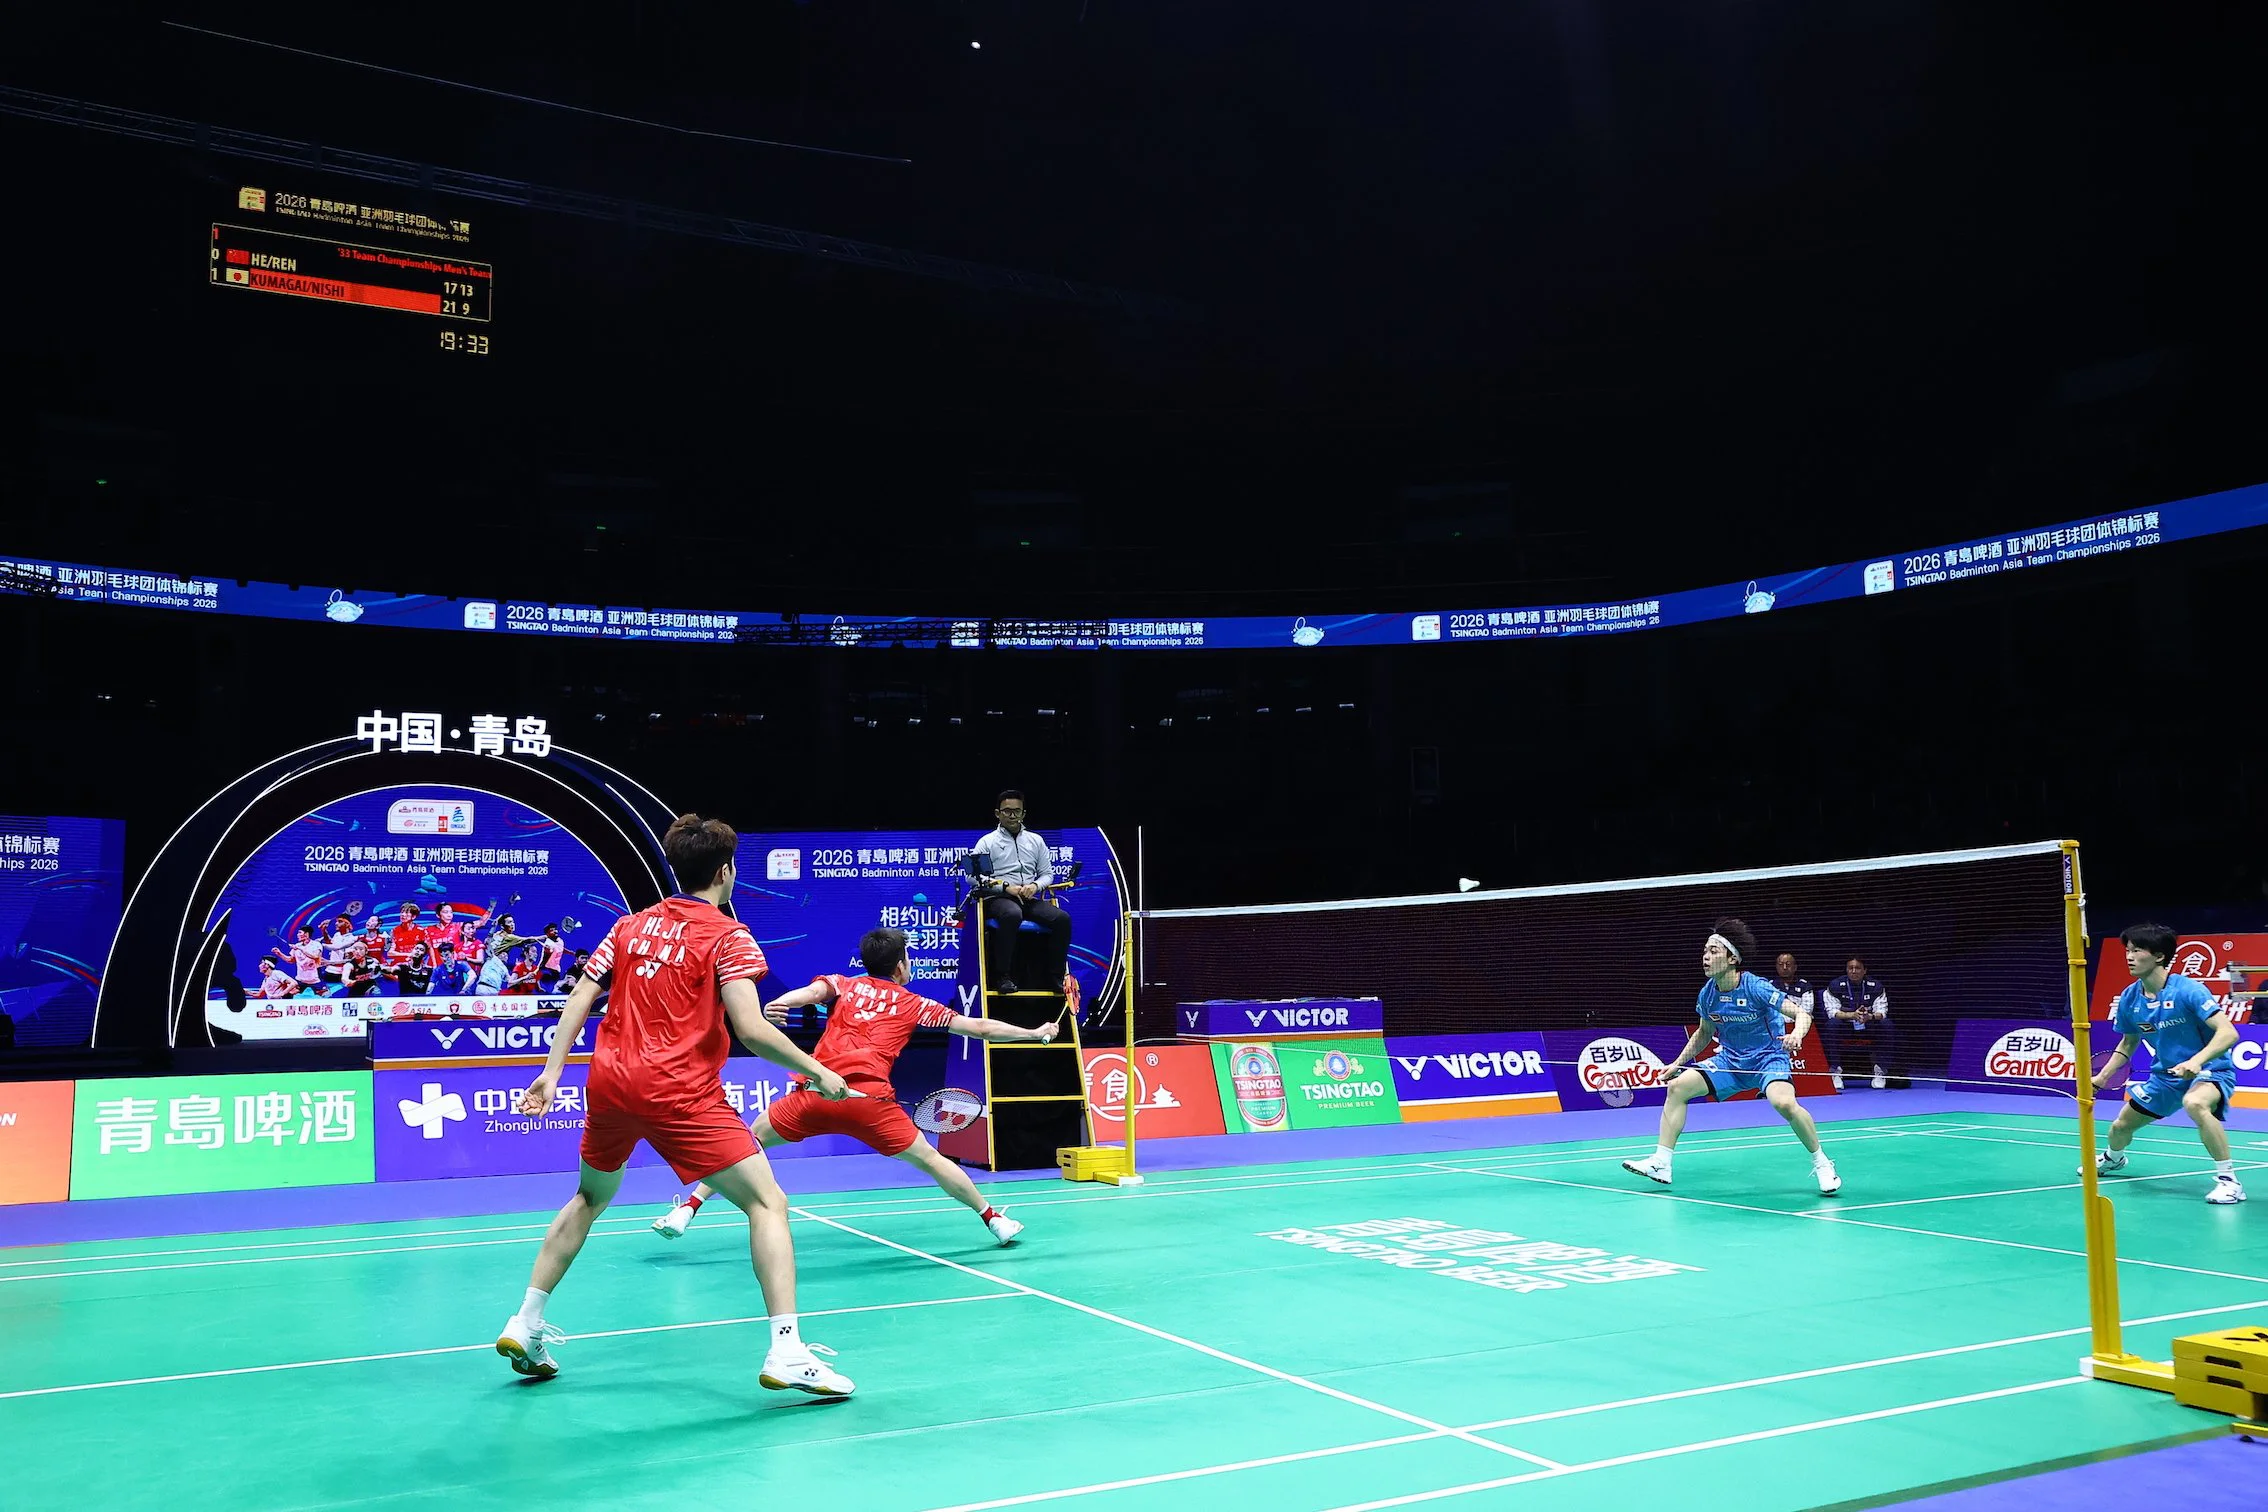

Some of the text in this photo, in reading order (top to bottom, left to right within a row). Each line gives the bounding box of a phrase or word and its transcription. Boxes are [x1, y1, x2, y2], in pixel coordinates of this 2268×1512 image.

[275, 192, 307, 209] 2026
[360, 206, 470, 235] 亚洲羽毛球团体赛
[352, 250, 376, 262] Team
[377, 254, 442, 273] Championships
[211, 248, 474, 297] 0 HE/REN 17 13
[211, 267, 470, 315] 1 KUMAGAI/NISHI 21 9
[440, 331, 489, 355] 19:33
[1904, 553, 1941, 575] 2026
[2006, 511, 2160, 556] 亚洲羽毛球团体锦标赛
[1904, 571, 1947, 587] TSINGTAO
[1949, 563, 2000, 580] Badminton
[2002, 558, 2024, 571] Asia
[2027, 553, 2054, 566] Team
[2056, 538, 2132, 561] Championships
[2135, 532, 2161, 547] 2026
[57, 567, 219, 598] 亚洲羽毛球团体锦标赛
[79, 586, 108, 599] Team
[111, 590, 190, 607] Championships
[193, 598, 218, 609] 2026
[506, 605, 544, 620] 2026
[607, 610, 739, 630] 亚洲羽毛球团体锦标赛
[1449, 614, 1485, 629] 2026
[1450, 629, 1490, 638] TSINGTAO
[1492, 626, 1537, 637] Badminton
[1540, 625, 1558, 634] Asia
[1561, 624, 1584, 633] Team
[1586, 618, 1647, 632] Championships
[506, 620, 549, 632] TSINGTAO
[551, 623, 599, 634] Badminton
[602, 626, 622, 635] Asia
[624, 627, 649, 637] Team
[650, 628, 715, 640] Championships
[1076, 638, 1095, 646] Asia
[1121, 637, 1182, 648] Championships
[1184, 636, 1204, 645] 2026
[356, 709, 551, 757] 中国·青岛
[30, 858, 59, 870] 2026
[304, 845, 345, 861] 2026
[412, 847, 549, 865] 亚洲羽毛球团体锦标赛
[812, 849, 853, 866] 2026
[303, 862, 549, 877] TSINGTAO Badminton Asia Team Championships 2026
[812, 868, 859, 879] TSINGTAO
[861, 867, 915, 878] Badminton
[918, 867, 940, 877] Asia
[626, 937, 686, 964] CHNA
[1270, 1007, 1349, 1028] VICTOR
[1589, 1045, 1642, 1063] 百岁山
[2005, 1036, 2061, 1052] 百岁山
[1432, 1050, 1545, 1079] VICTOR
[1234, 1078, 1282, 1091] TSINGTAO
[1300, 1081, 1385, 1101] TSINGTAO
[1318, 1100, 1376, 1110] PREMIUM BEER
[93, 1089, 357, 1156] 青島啤酒
[484, 1117, 586, 1135] Zhonglu Insura
[1251, 1226, 1570, 1295] TSINGTAO BEER
